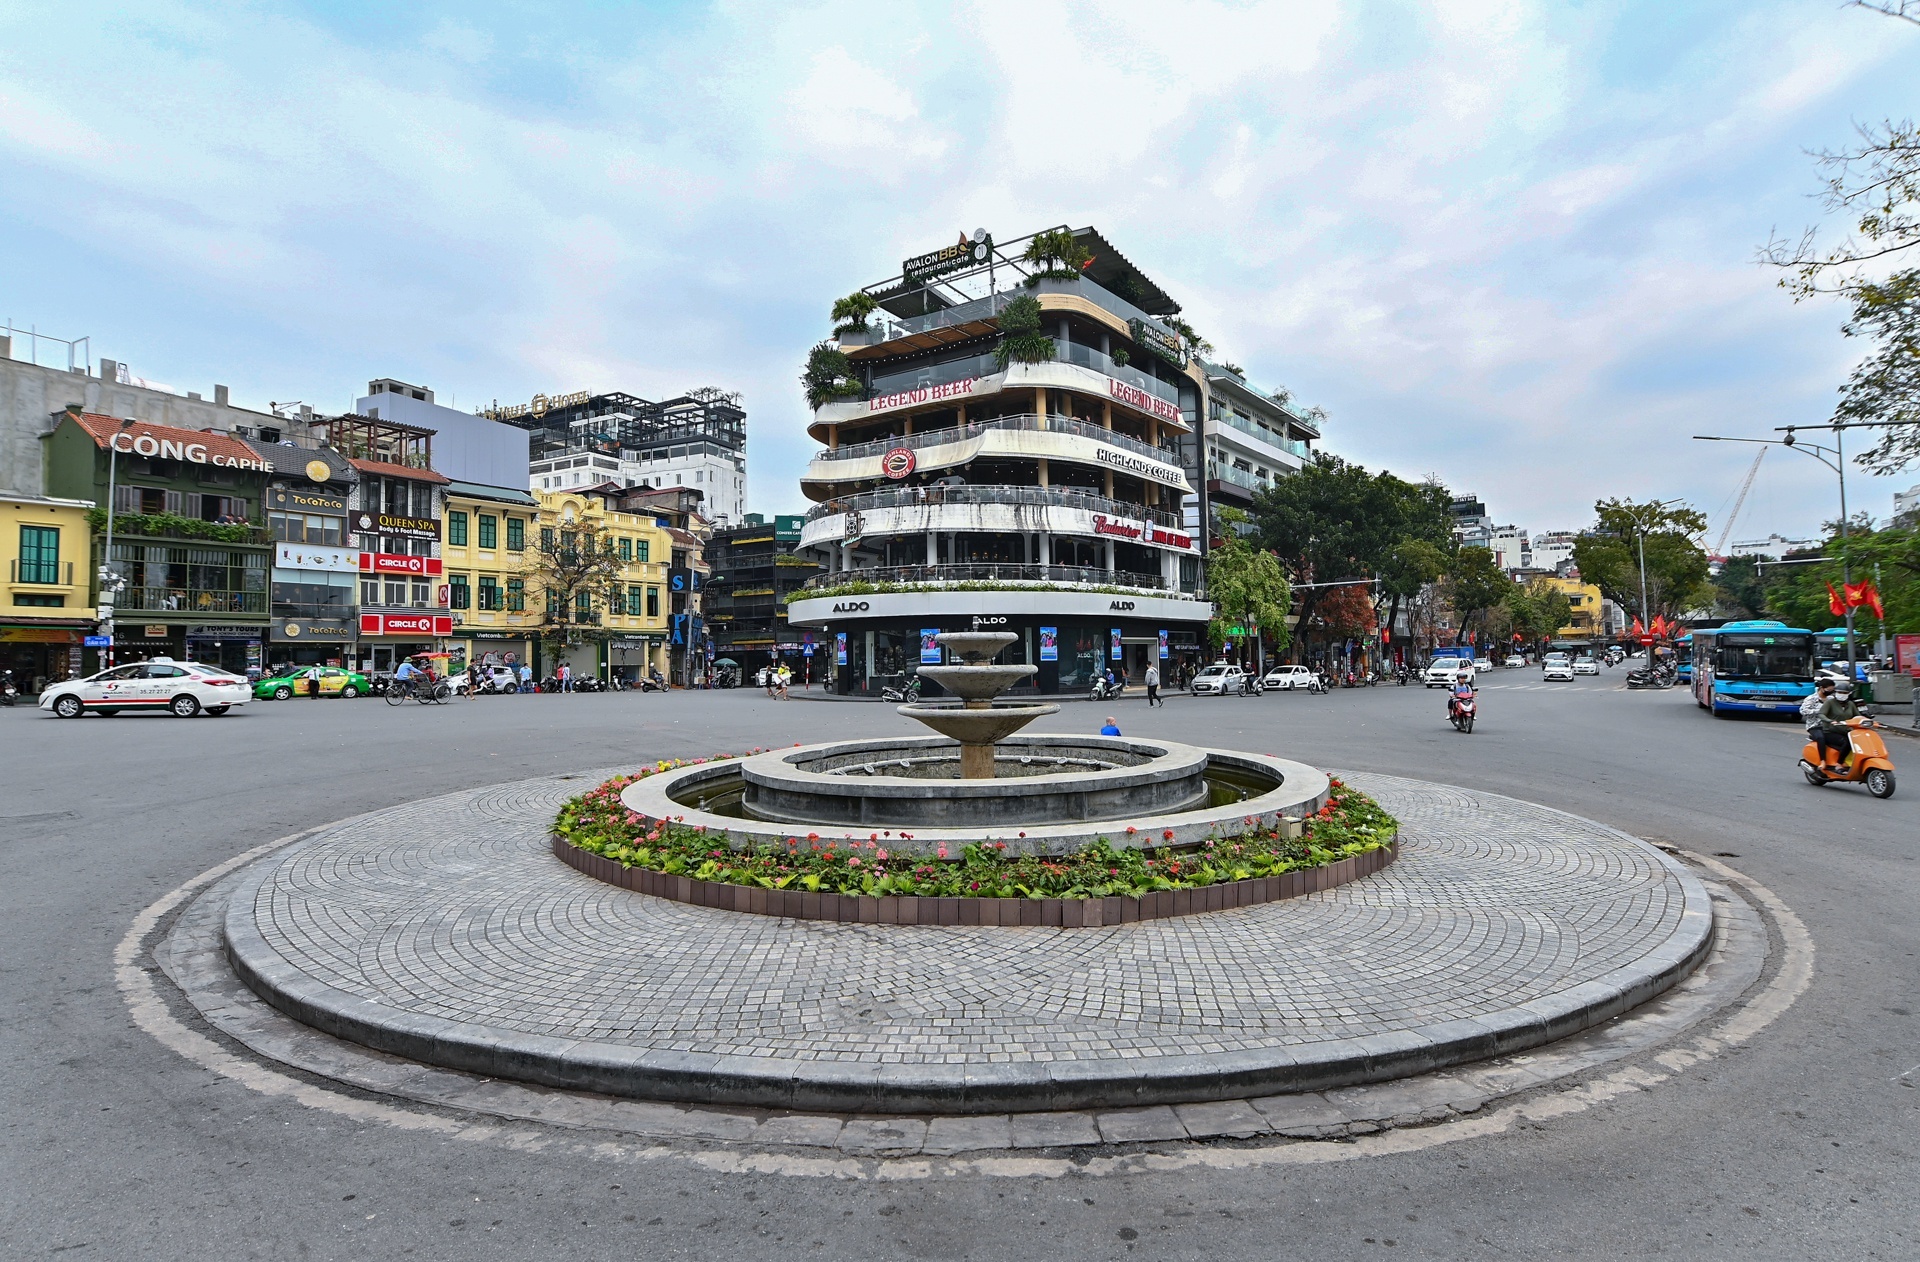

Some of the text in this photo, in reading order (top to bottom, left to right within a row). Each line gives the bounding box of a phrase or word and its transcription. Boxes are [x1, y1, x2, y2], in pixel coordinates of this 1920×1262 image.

[906, 254, 938, 270] AVALON
[911, 254, 968, 277] restaurant cafe
[1142, 324, 1164, 342] AVALON
[870, 388, 928, 411] LEGEND
[1109, 378, 1152, 410] LEGEND
[500, 404, 526, 420] VILLE
[552, 390, 589, 409] HOTEL
[884, 450, 913, 464] HIGHLANDS
[888, 468, 910, 477] COFFEE
[1098, 448, 1181, 483] HIGHLANDS COFFEE
[379, 515, 435, 531] QUEEN SPA
[1093, 515, 1141, 538] Budweiser
[413, 529, 435, 537] Massage
[379, 559, 407, 568] CIRCLE
[833, 602, 869, 612] ALDO
[1110, 600, 1135, 611] ALDO
